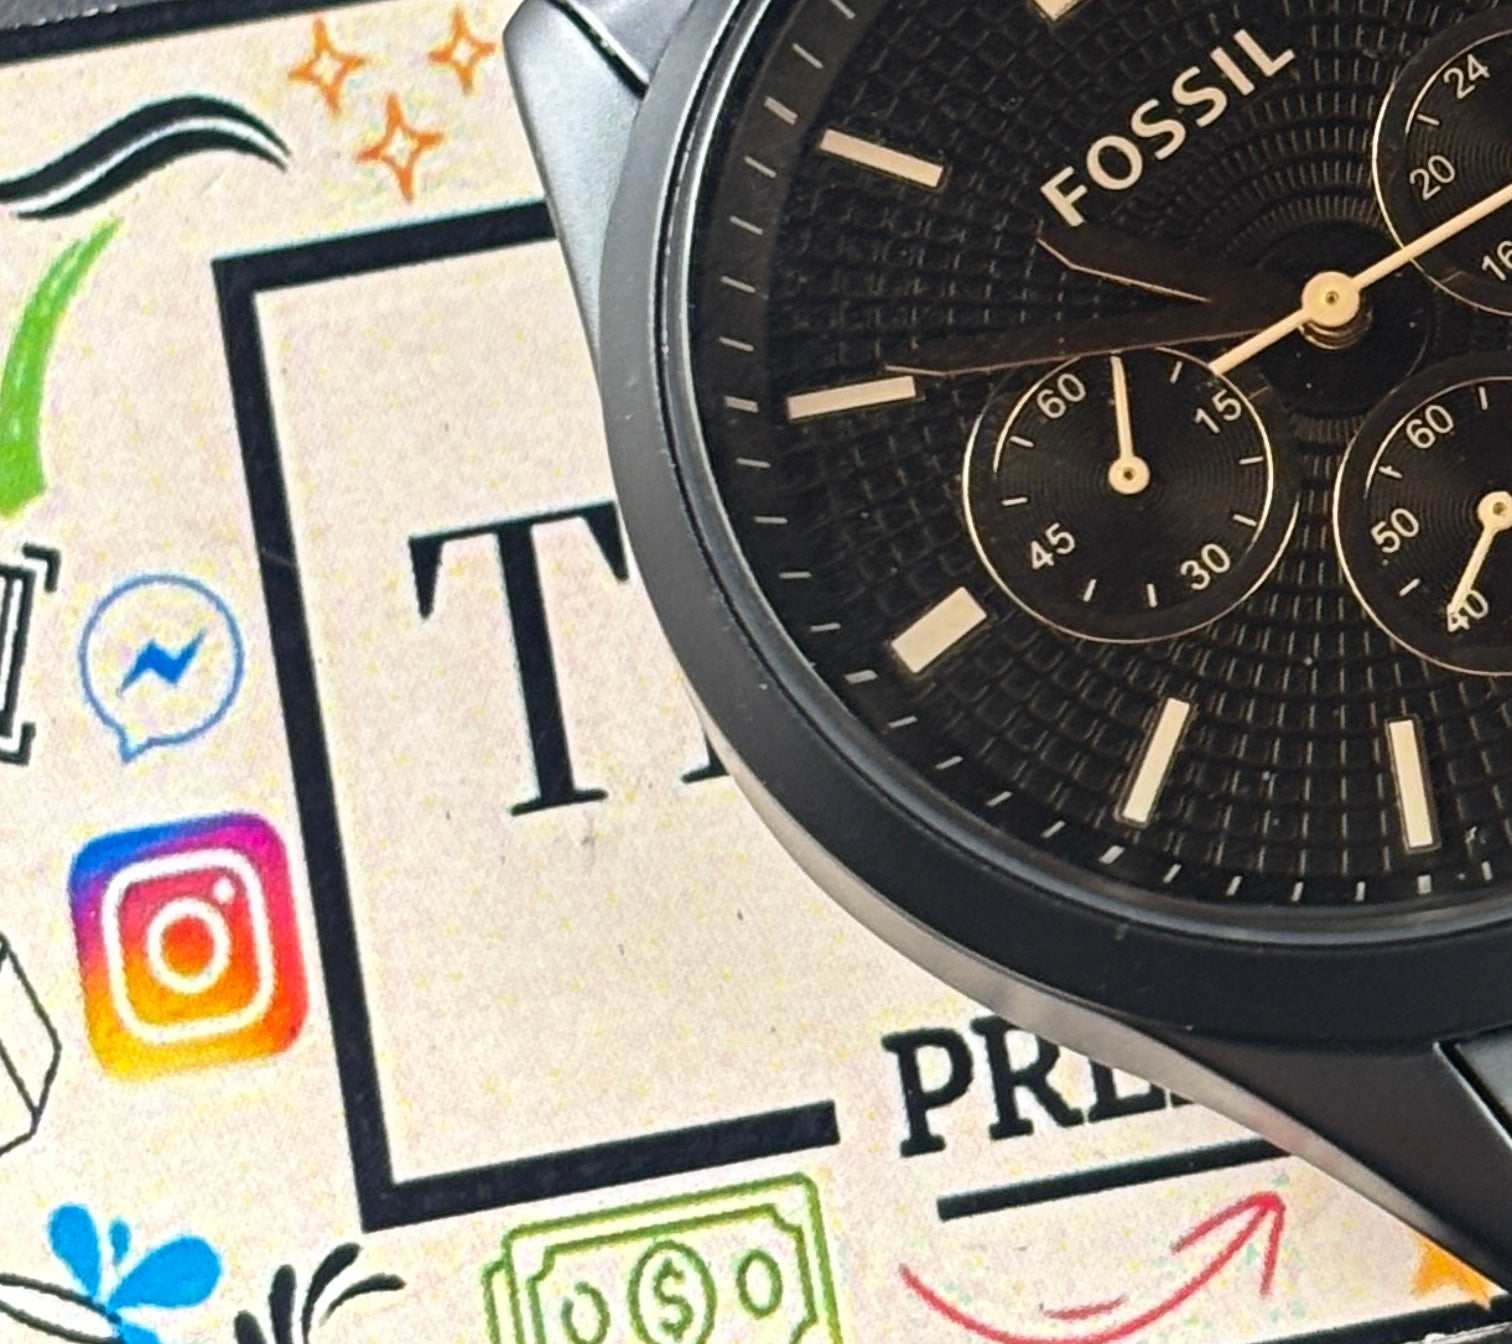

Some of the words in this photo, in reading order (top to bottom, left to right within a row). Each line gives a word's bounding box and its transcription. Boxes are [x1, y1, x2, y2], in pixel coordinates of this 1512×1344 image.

[1443, 54, 1490, 99] 24
[1040, 28, 1296, 227] FOSSIL
[1409, 155, 1455, 201] 20
[1036, 373, 1087, 419] 60
[1194, 389, 1242, 434] 15
[1405, 404, 1454, 449] 60
[1030, 523, 1076, 570] 45
[1370, 508, 1420, 553] 50
[1180, 543, 1231, 590] 30
[1447, 590, 1489, 632] 40
